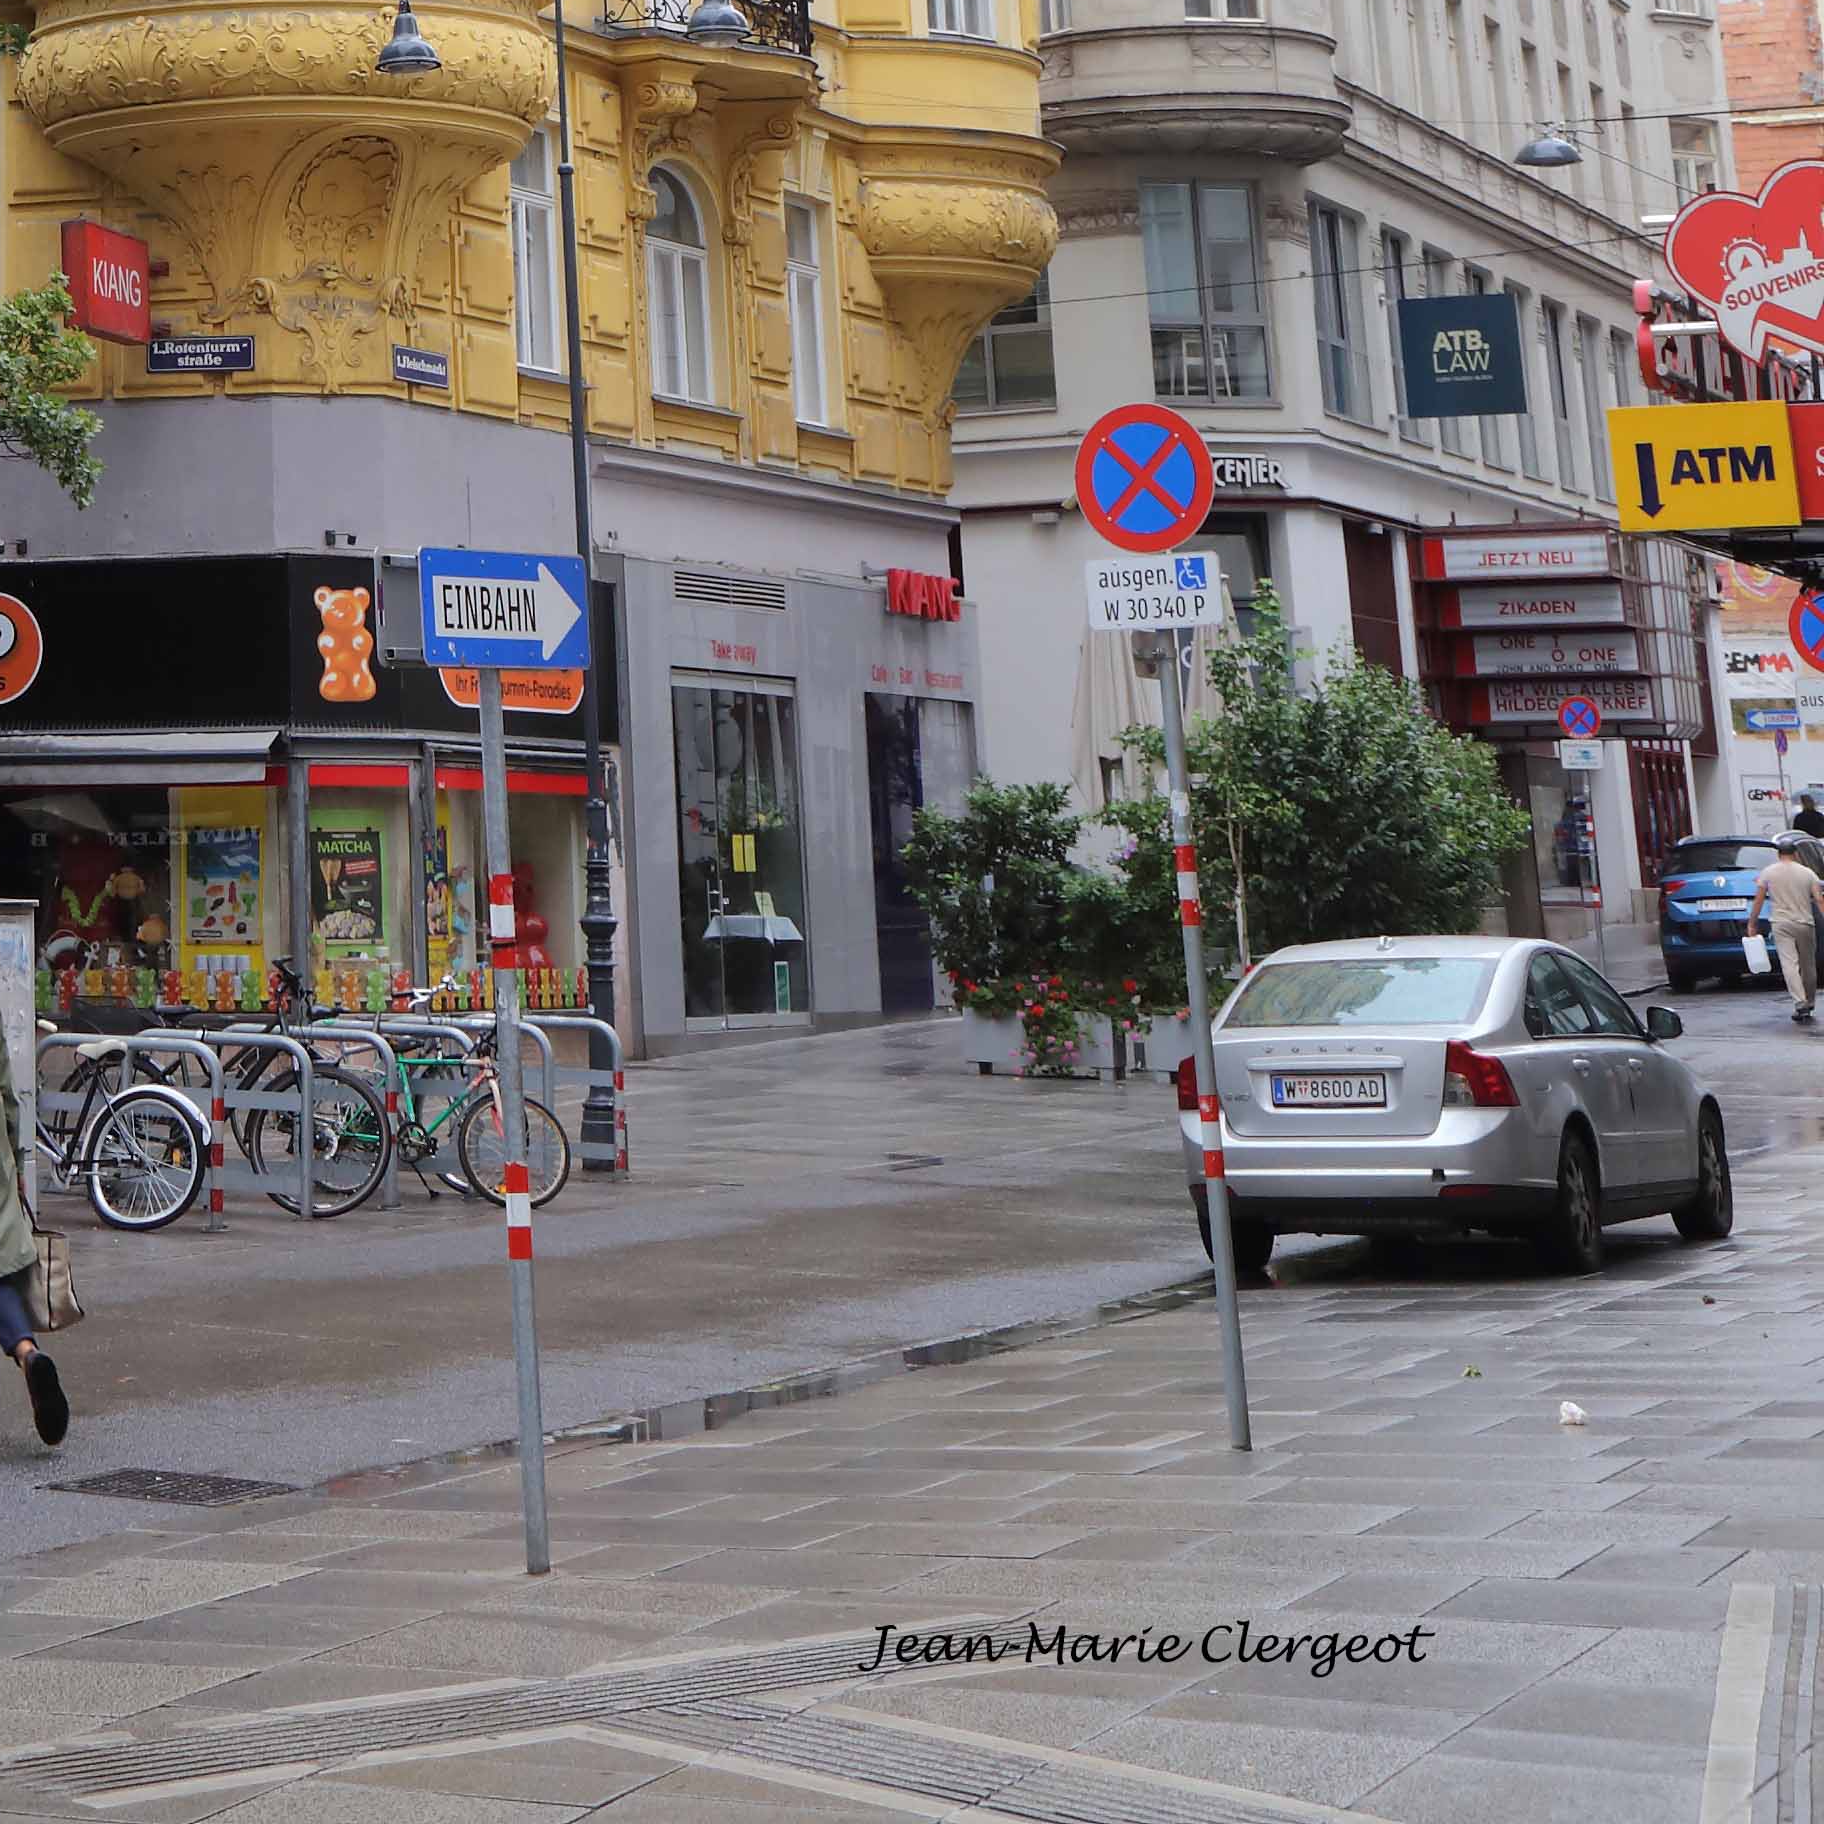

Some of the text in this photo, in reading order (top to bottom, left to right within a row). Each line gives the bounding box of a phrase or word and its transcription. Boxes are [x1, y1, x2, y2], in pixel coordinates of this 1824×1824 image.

[92, 256, 142, 308] KIANG
[1433, 329, 1490, 352] ATB.
[177, 354, 222, 367] straße
[1433, 351, 1490, 374] LAW
[1213, 456, 1290, 490] CENTER
[1670, 445, 1776, 486] ATM
[1478, 551, 1574, 567] JETZT NEU
[1098, 567, 1175, 592] ausgen.
[442, 583, 537, 633] EINBAHN
[1104, 600, 1120, 621] W
[1194, 595, 1205, 617] P
[1499, 600, 1576, 615] ZIKADEN
[1500, 635, 1536, 649] ONE
[1578, 648, 1617, 662] ONE
[1495, 683, 1524, 697] ICH
[1533, 682, 1577, 697] WILL
[1602, 696, 1648, 711] KNEF
[317, 840, 373, 854] MATCHA
[1283, 1079, 1380, 1098] W 8600 AD
